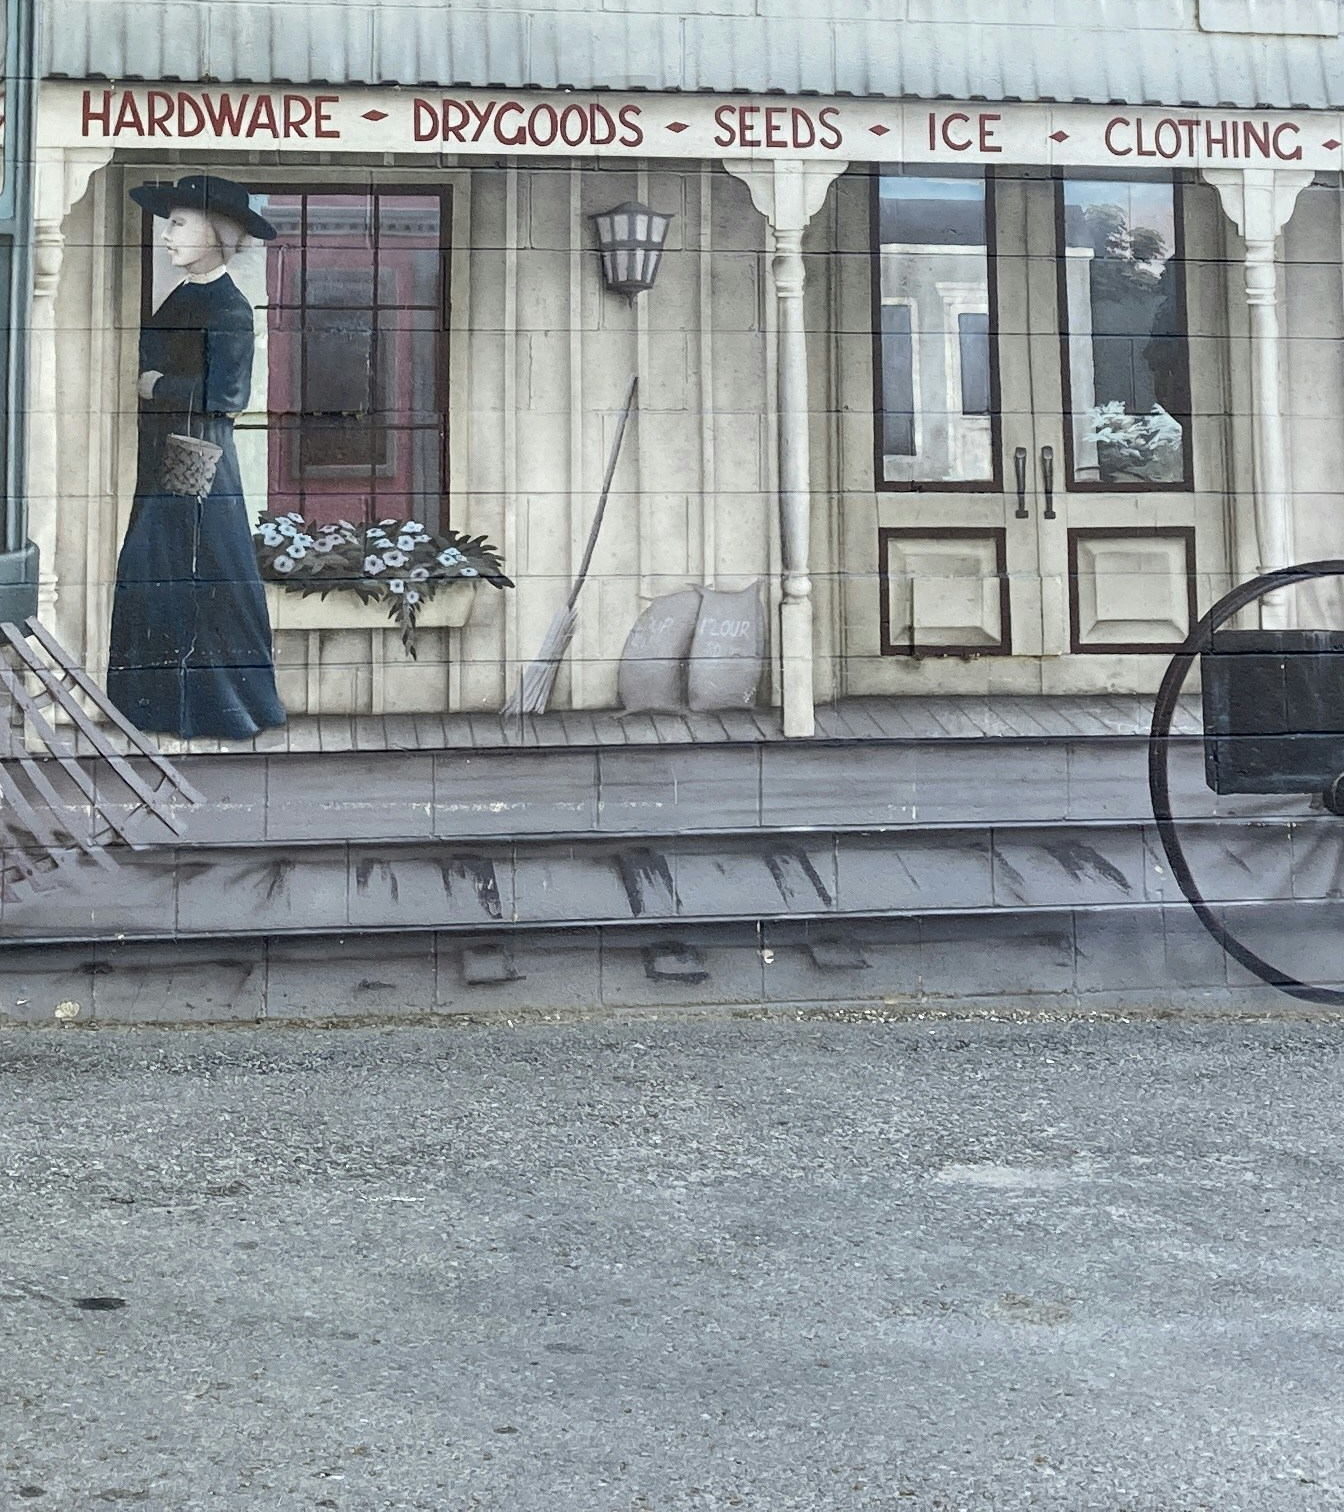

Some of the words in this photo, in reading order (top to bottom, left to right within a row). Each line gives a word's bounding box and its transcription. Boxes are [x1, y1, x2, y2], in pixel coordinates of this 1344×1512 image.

[81, 90, 341, 139] HARDWARE
[413, 98, 644, 148] DRYGOODS
[713, 104, 843, 150] SEEDS
[928, 112, 1003, 153] ICE
[1104, 116, 1303, 161] CLOTHING
